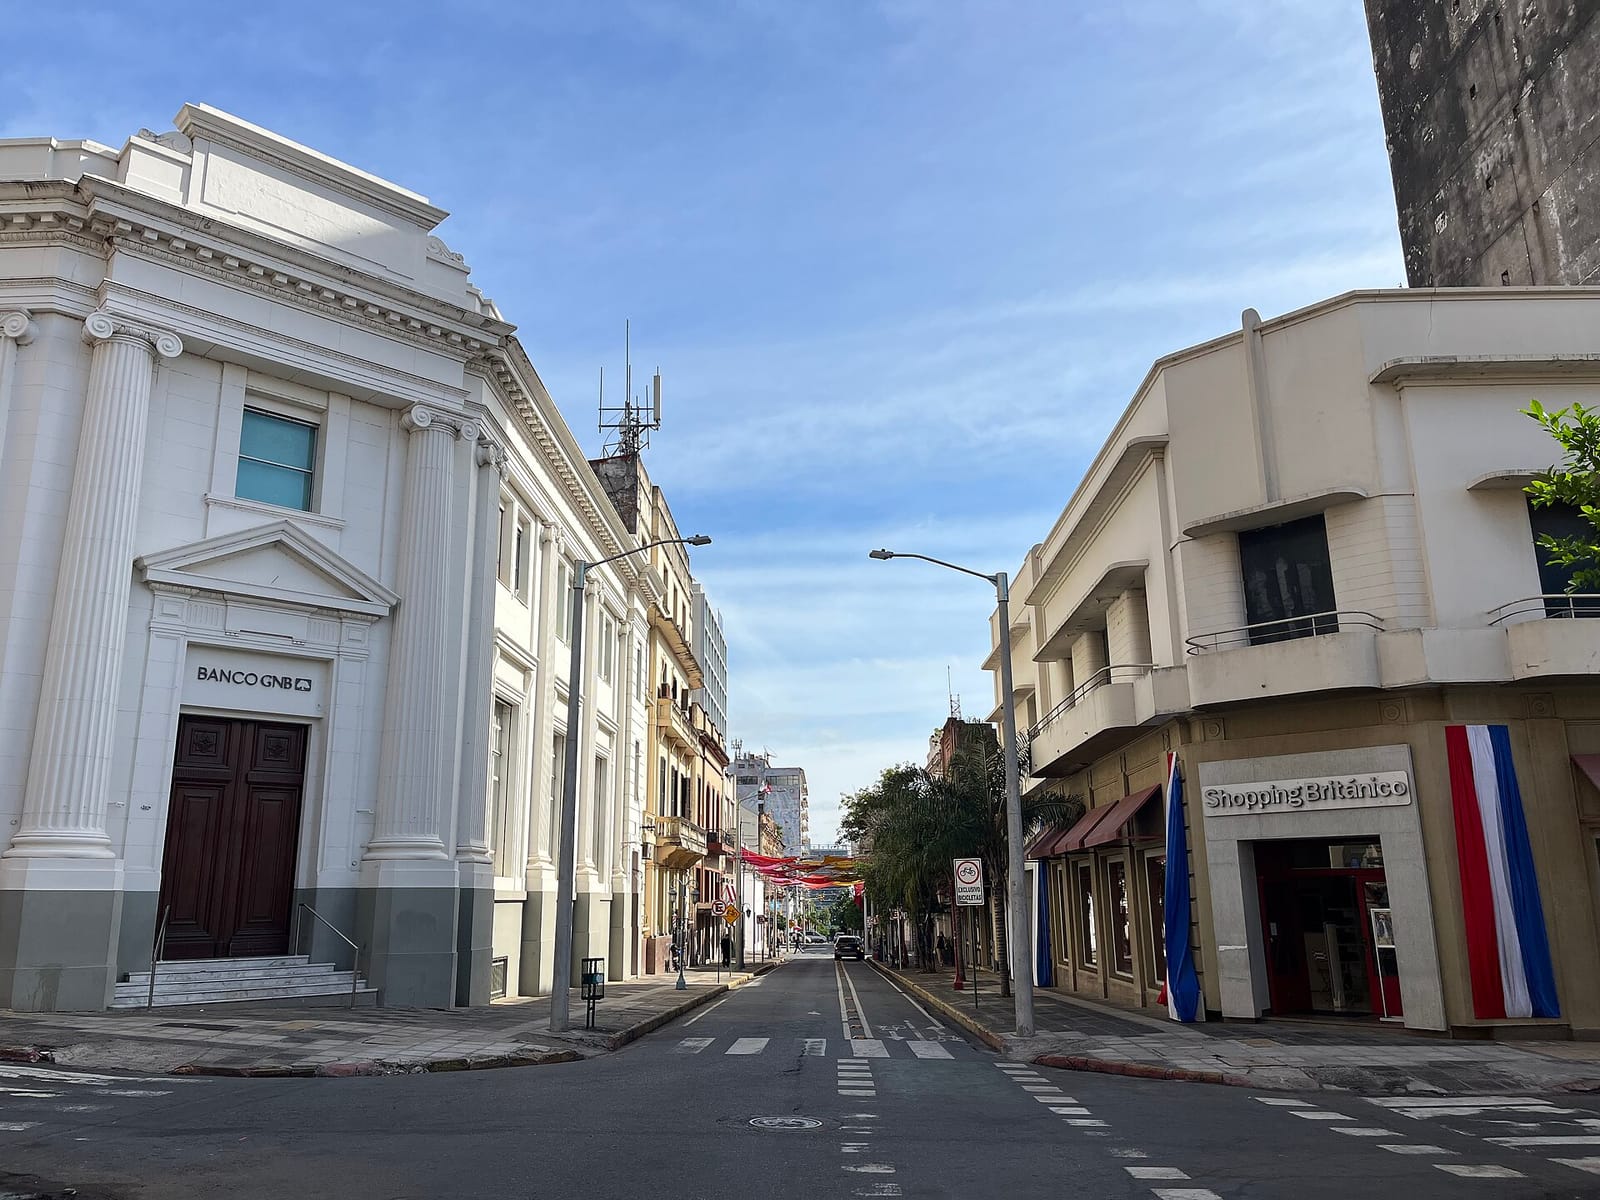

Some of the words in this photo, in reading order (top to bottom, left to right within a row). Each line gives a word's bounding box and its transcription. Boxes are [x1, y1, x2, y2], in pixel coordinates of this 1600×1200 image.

[197, 666, 259, 686] BANCO
[260, 674, 293, 690] GNB
[1205, 785, 1304, 809] Shopping
[1304, 777, 1407, 802] Británico
